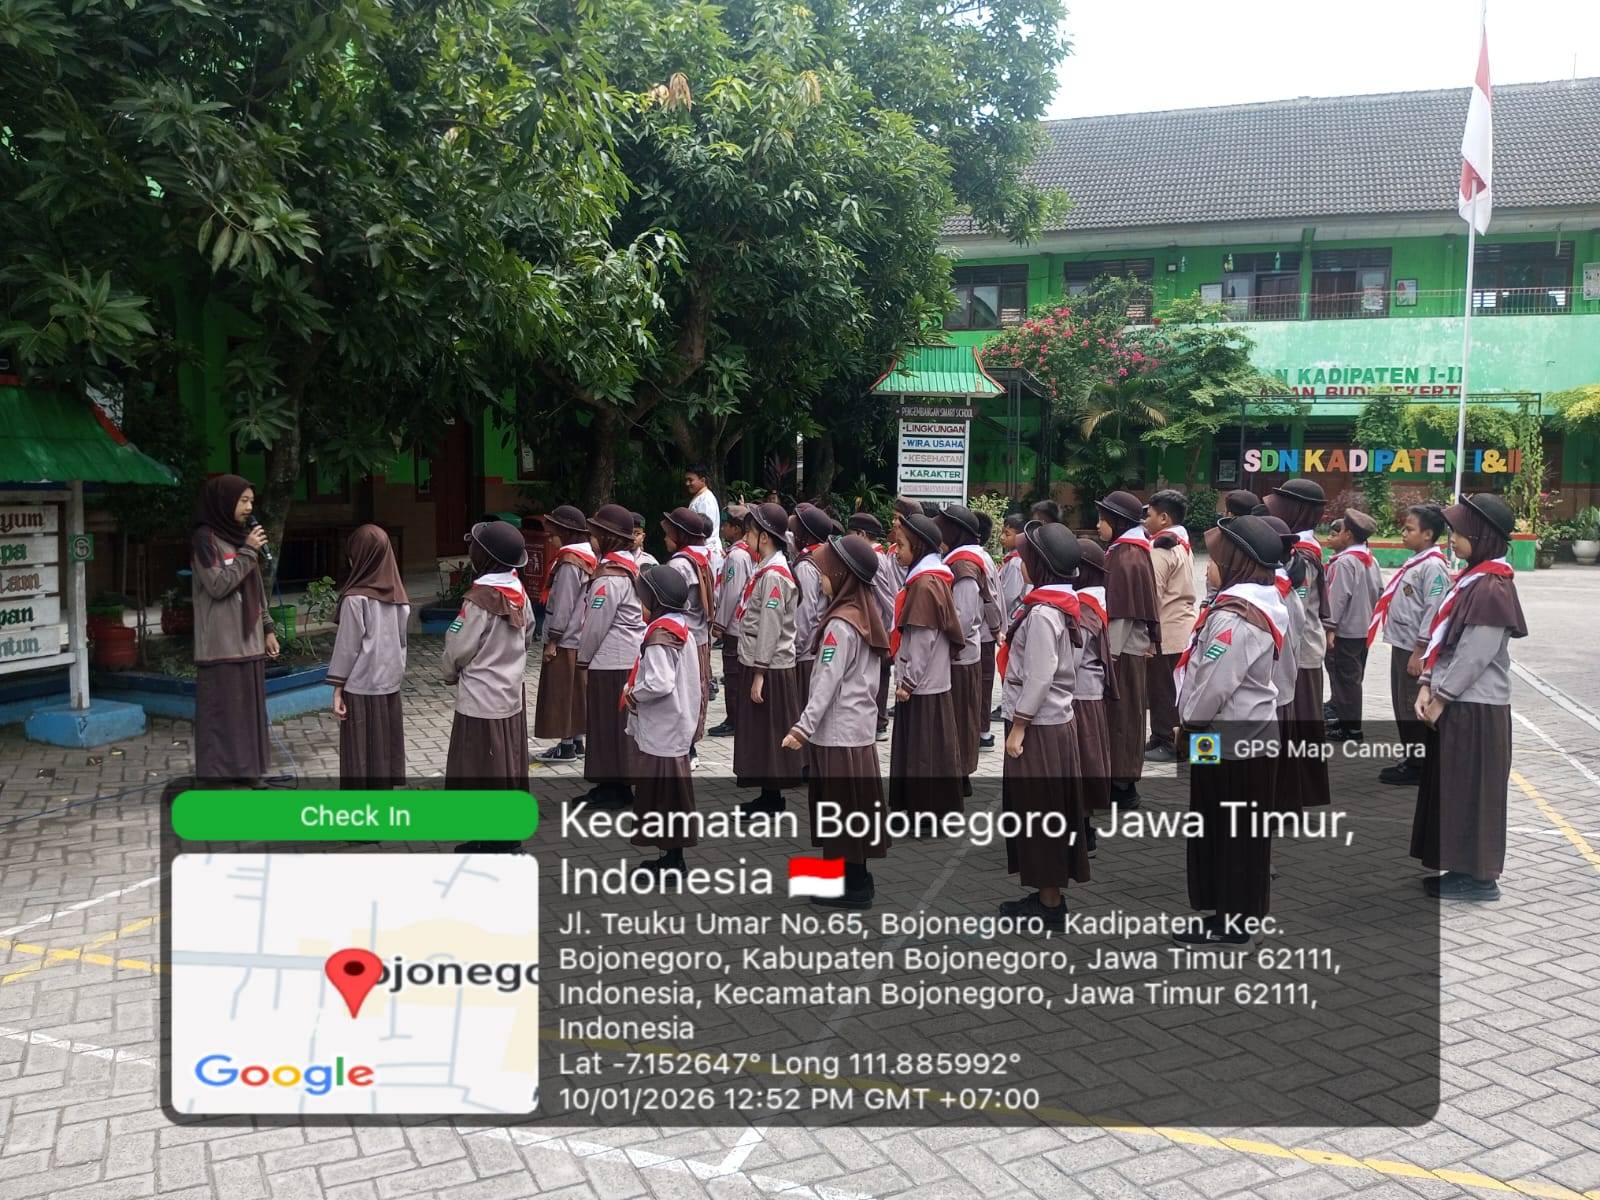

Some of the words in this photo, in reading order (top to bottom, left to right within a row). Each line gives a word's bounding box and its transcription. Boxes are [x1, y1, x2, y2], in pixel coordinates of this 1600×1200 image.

[1297, 367, 1419, 385] KADIPATEN
[956, 408, 974, 418] SCHOOL
[905, 424, 965, 433] LINGKUNGAN
[907, 439, 931, 448] WIRA
[932, 440, 964, 449] USAHA
[908, 454, 963, 463] KESEHATAN
[1243, 449, 1299, 473] SDN
[1304, 448, 1464, 473] KADIPATEN
[909, 469, 961, 479] KARAKTER
